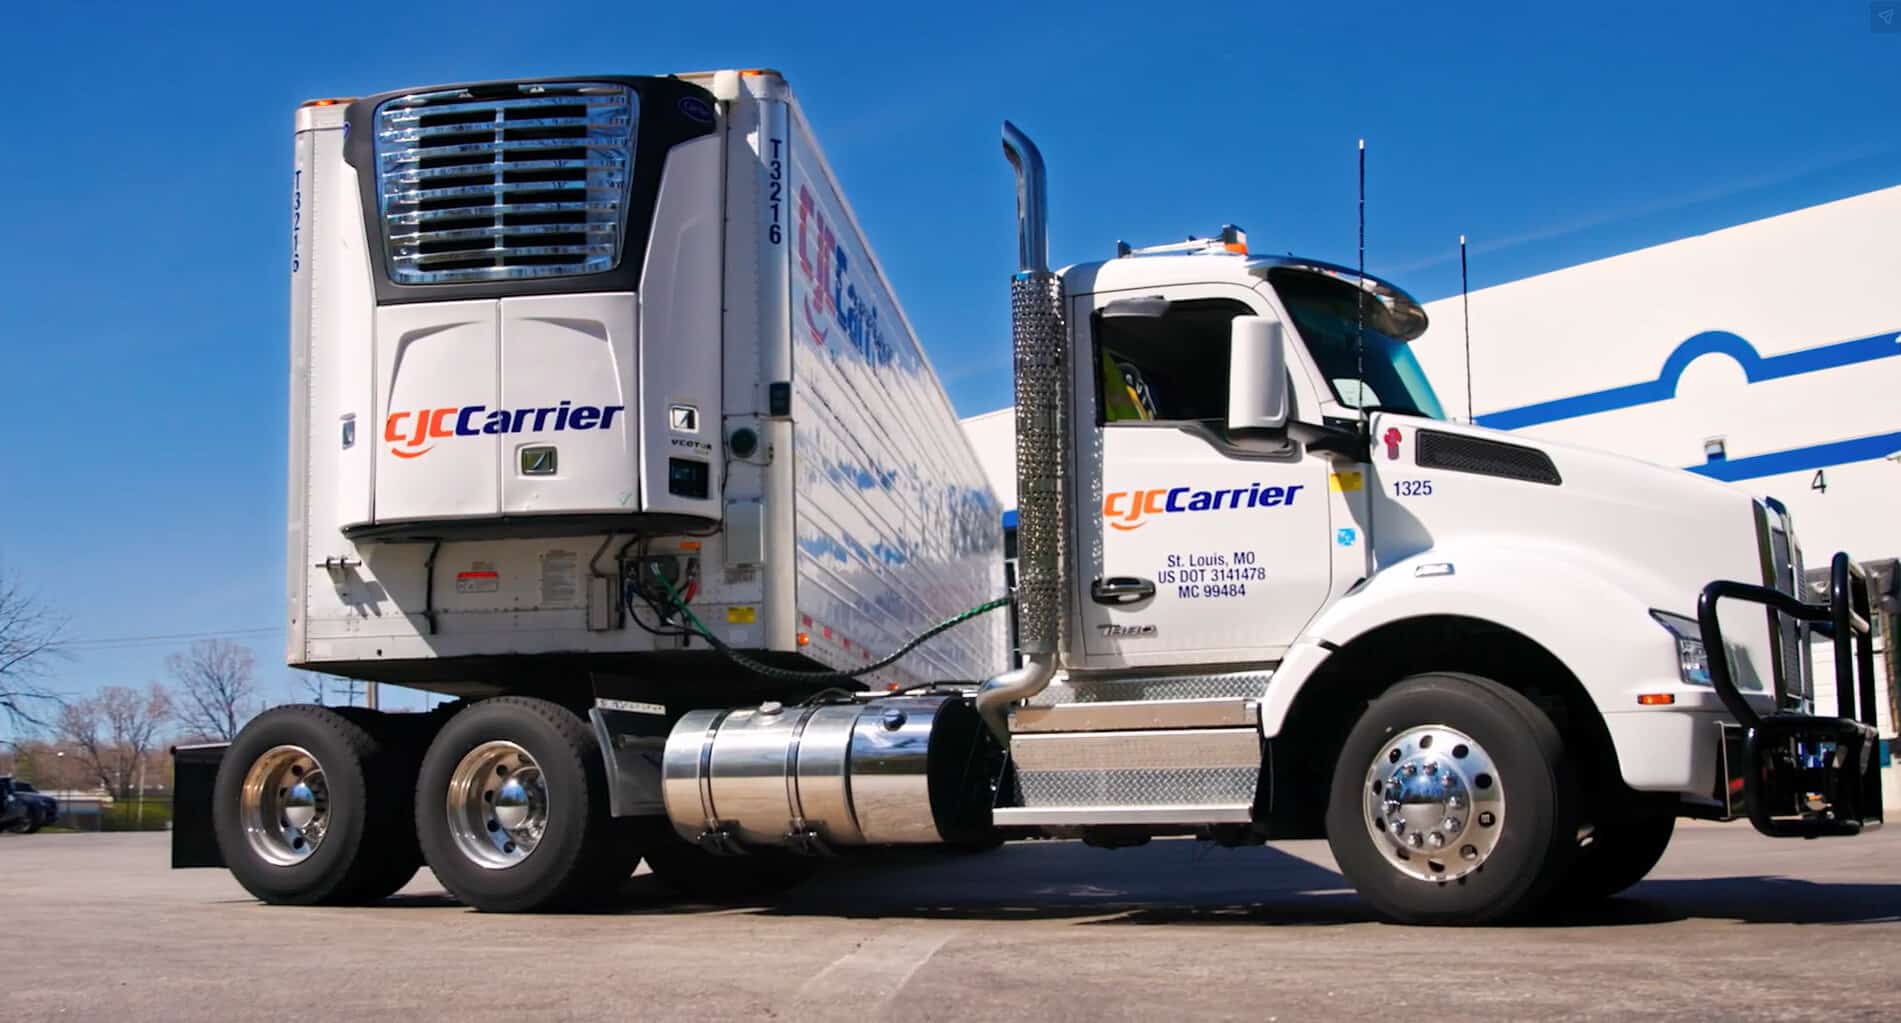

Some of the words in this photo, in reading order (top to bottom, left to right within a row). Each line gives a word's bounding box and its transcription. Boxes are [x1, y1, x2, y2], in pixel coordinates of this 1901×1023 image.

[769, 138, 783, 245] T3216
[1393, 480, 1433, 497] 1325
[1811, 469, 1827, 494] 4
[1167, 554, 1184, 568] St.
[1189, 553, 1229, 567] Louis,
[1233, 551, 1255, 565] MO
[1158, 570, 1176, 584] US
[1180, 569, 1206, 583] DOT
[1211, 567, 1266, 582] 3141478
[1178, 585, 1200, 599] MC
[1203, 583, 1246, 598] 99484
